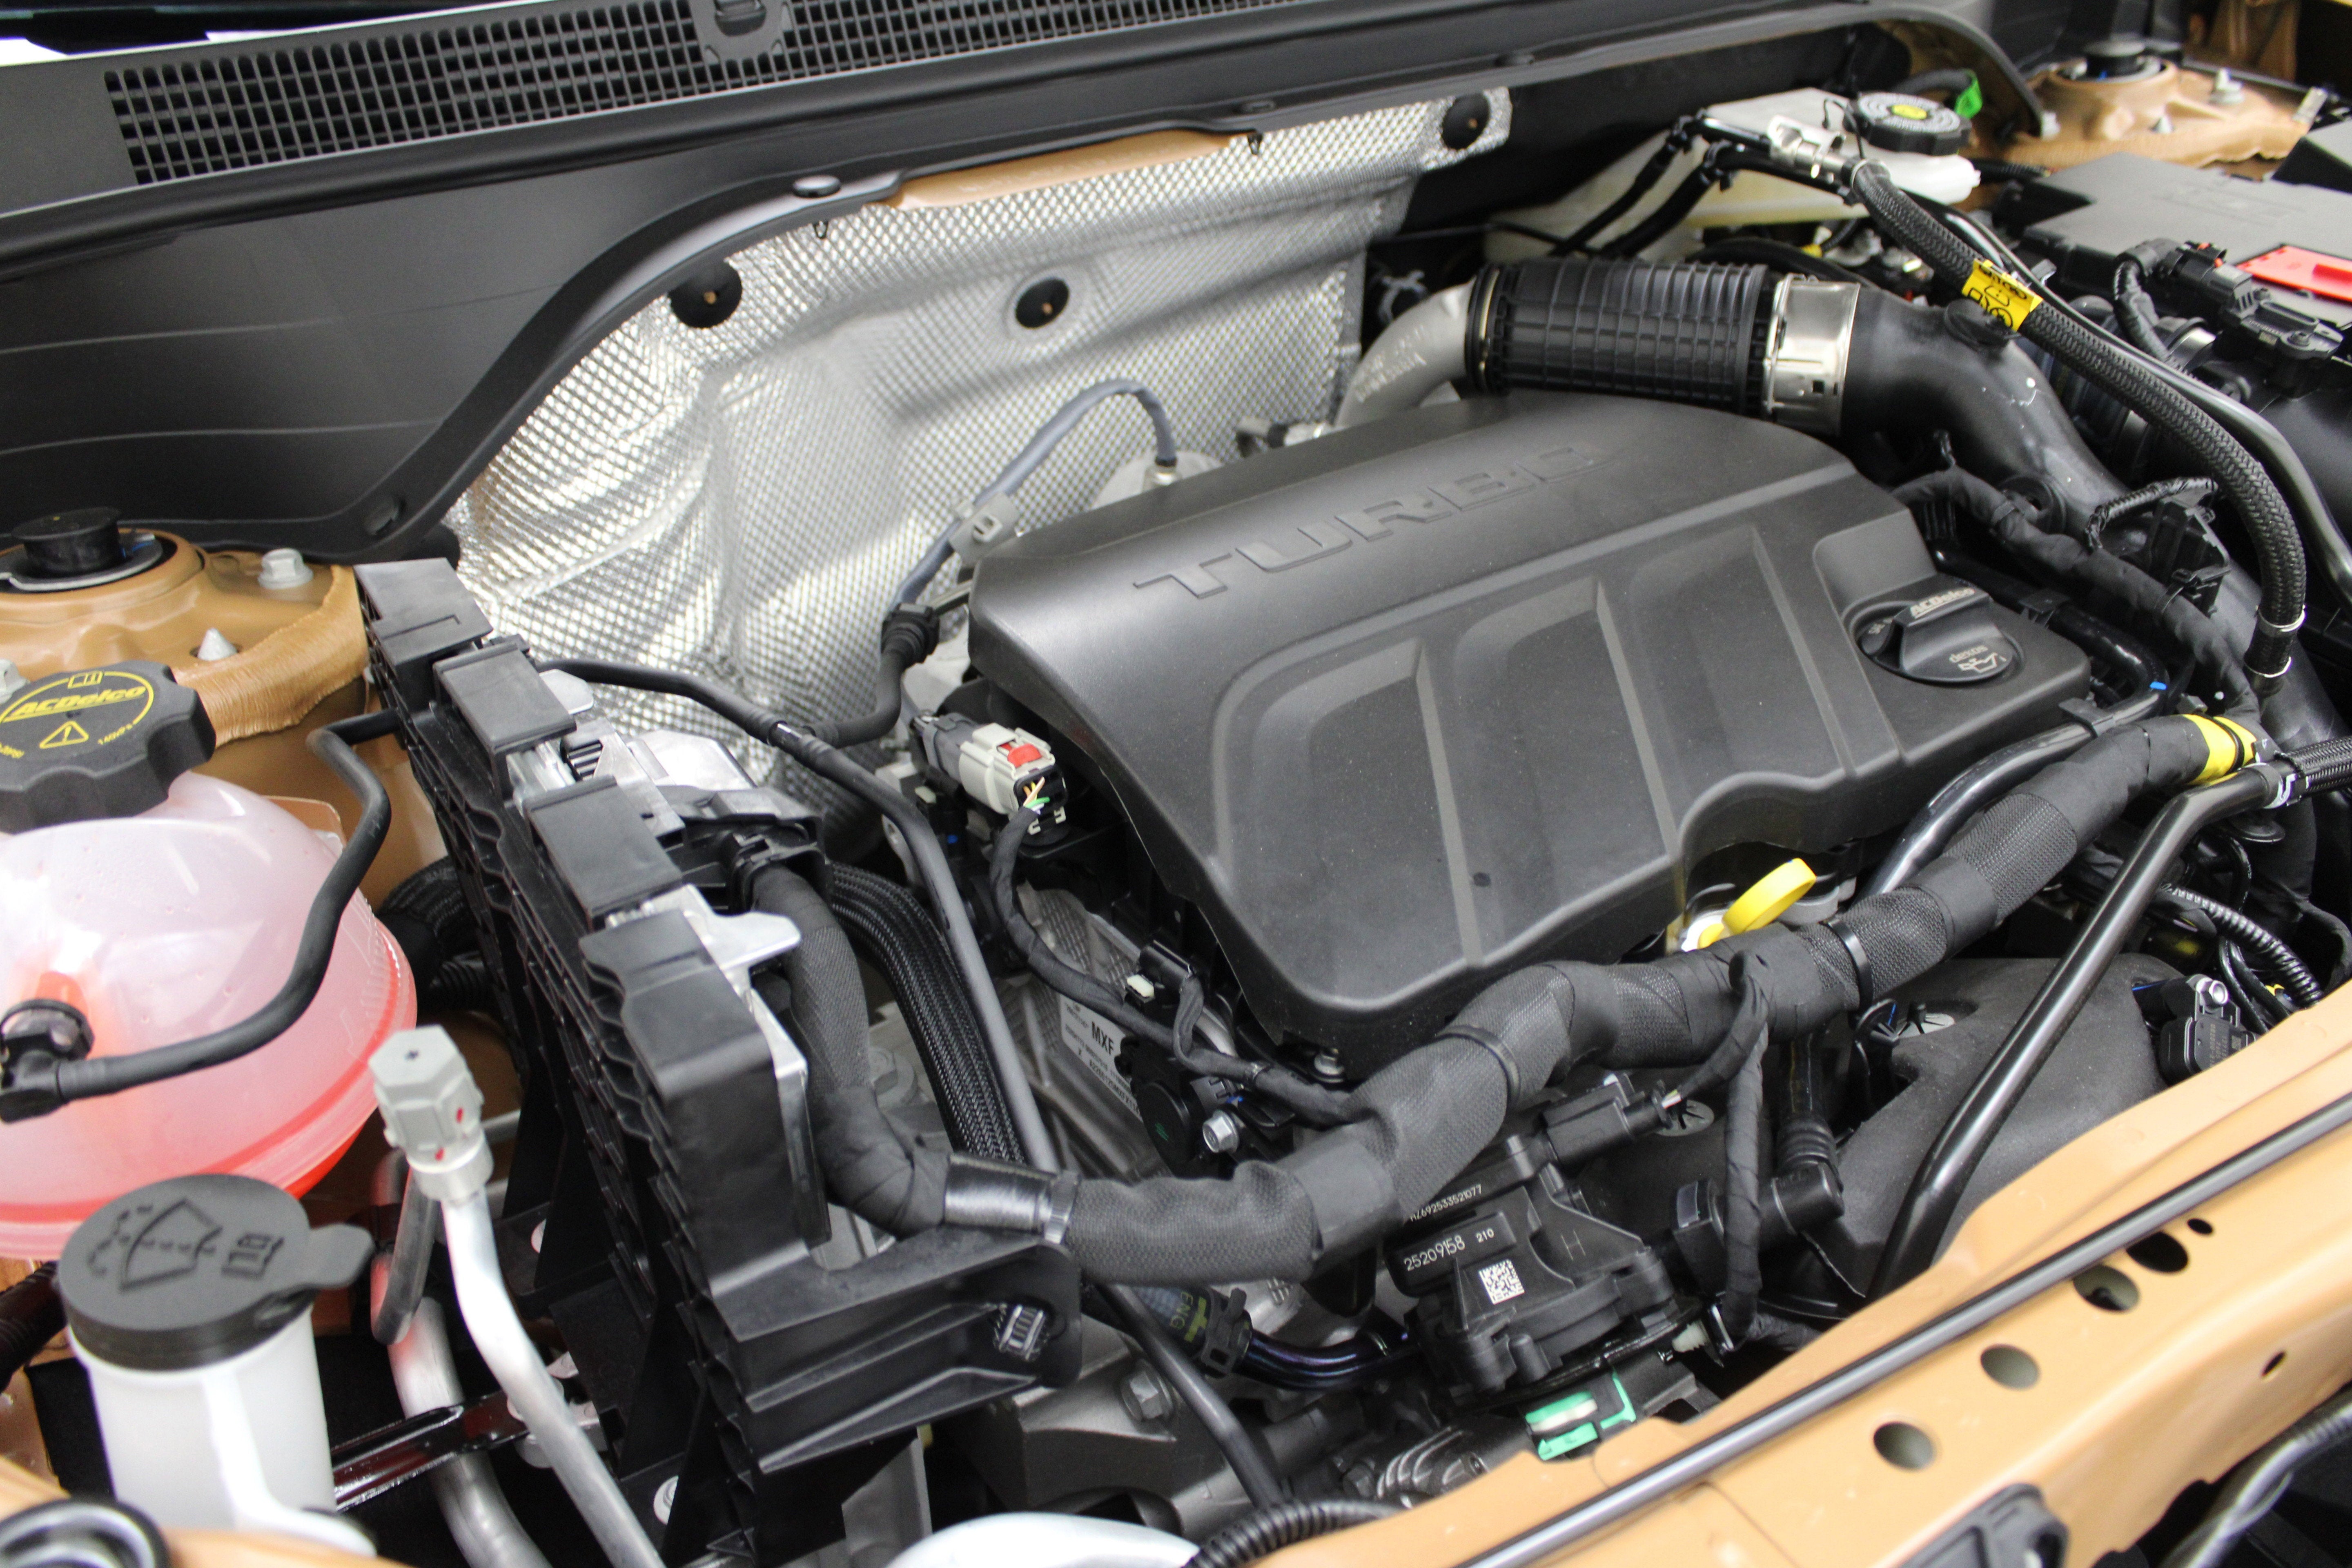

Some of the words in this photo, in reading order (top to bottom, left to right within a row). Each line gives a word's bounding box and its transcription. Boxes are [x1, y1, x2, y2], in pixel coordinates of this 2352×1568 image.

[1132, 443, 1610, 599] TURBO
[1910, 587, 1975, 618] ACDelco
[1949, 645, 1989, 663] dexos
[11, 686, 146, 716] ACDelco
[1091, 1021, 1114, 1055] MXF
[1403, 1234, 1465, 1272] 25209158
[1476, 1227, 1494, 1243] 210
[1170, 1291, 1194, 1330] ENG
